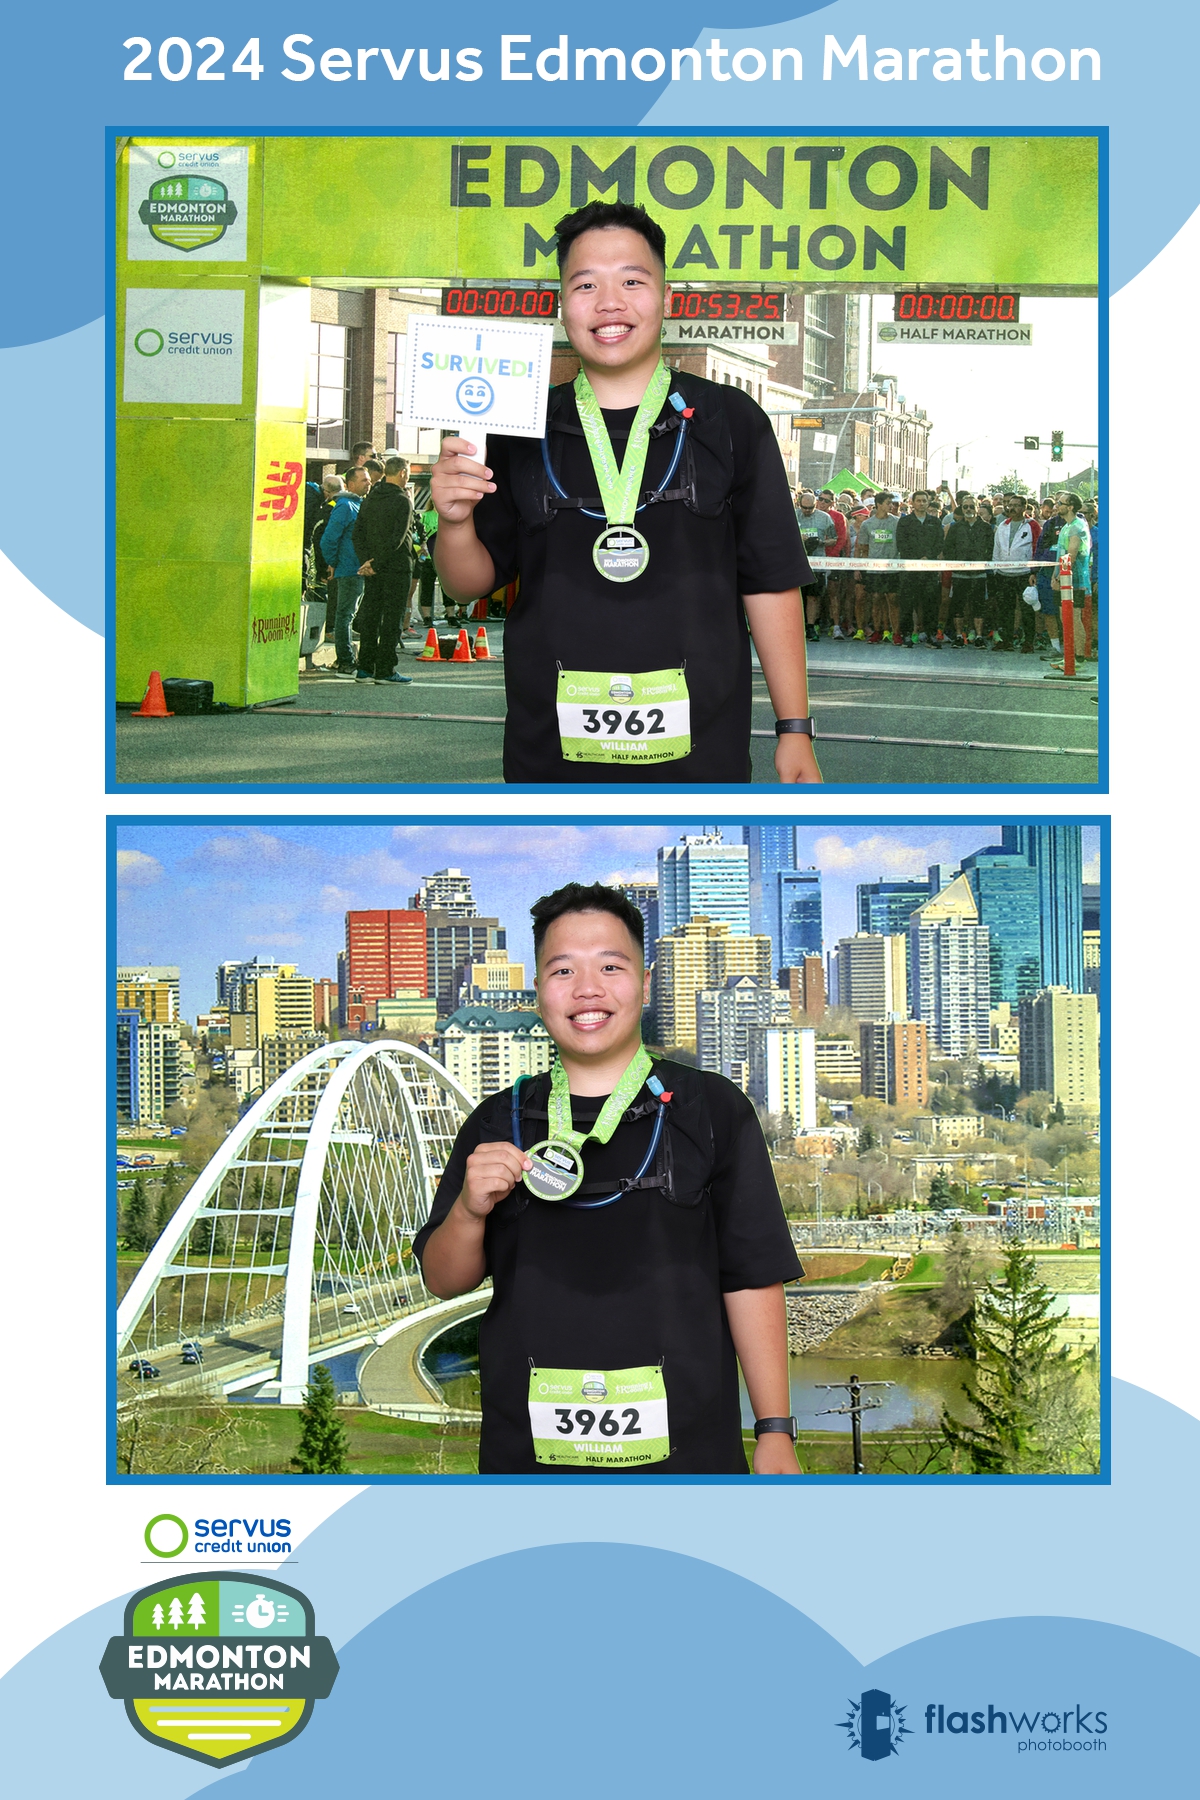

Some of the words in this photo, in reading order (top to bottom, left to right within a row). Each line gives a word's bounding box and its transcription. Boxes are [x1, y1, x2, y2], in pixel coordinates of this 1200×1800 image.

[178, 151, 220, 161] servus
[450, 144, 991, 212] EDMONTON
[149, 202, 227, 214] EDMONTON
[160, 213, 216, 222] MARATHON
[523, 222, 907, 271] MATHON
[168, 331, 234, 345] servus
[678, 324, 786, 341] MARATHON
[900, 327, 940, 340] HALF
[942, 328, 1031, 341] MARATHON
[475, 333, 483, 351] I
[167, 345, 200, 355] credit
[203, 346, 233, 355] union
[420, 351, 534, 379] SURVIVED!
[603, 560, 640, 568] MARATHON
[581, 708, 666, 736] 3962
[600, 741, 648, 751] WILLIAM
[631, 751, 674, 760] MARATHON
[530, 1170, 567, 1192] MARATHON
[554, 1407, 642, 1437] 3962
[573, 1444, 623, 1454] WILLIAM
[606, 1453, 652, 1463] MARATHON
